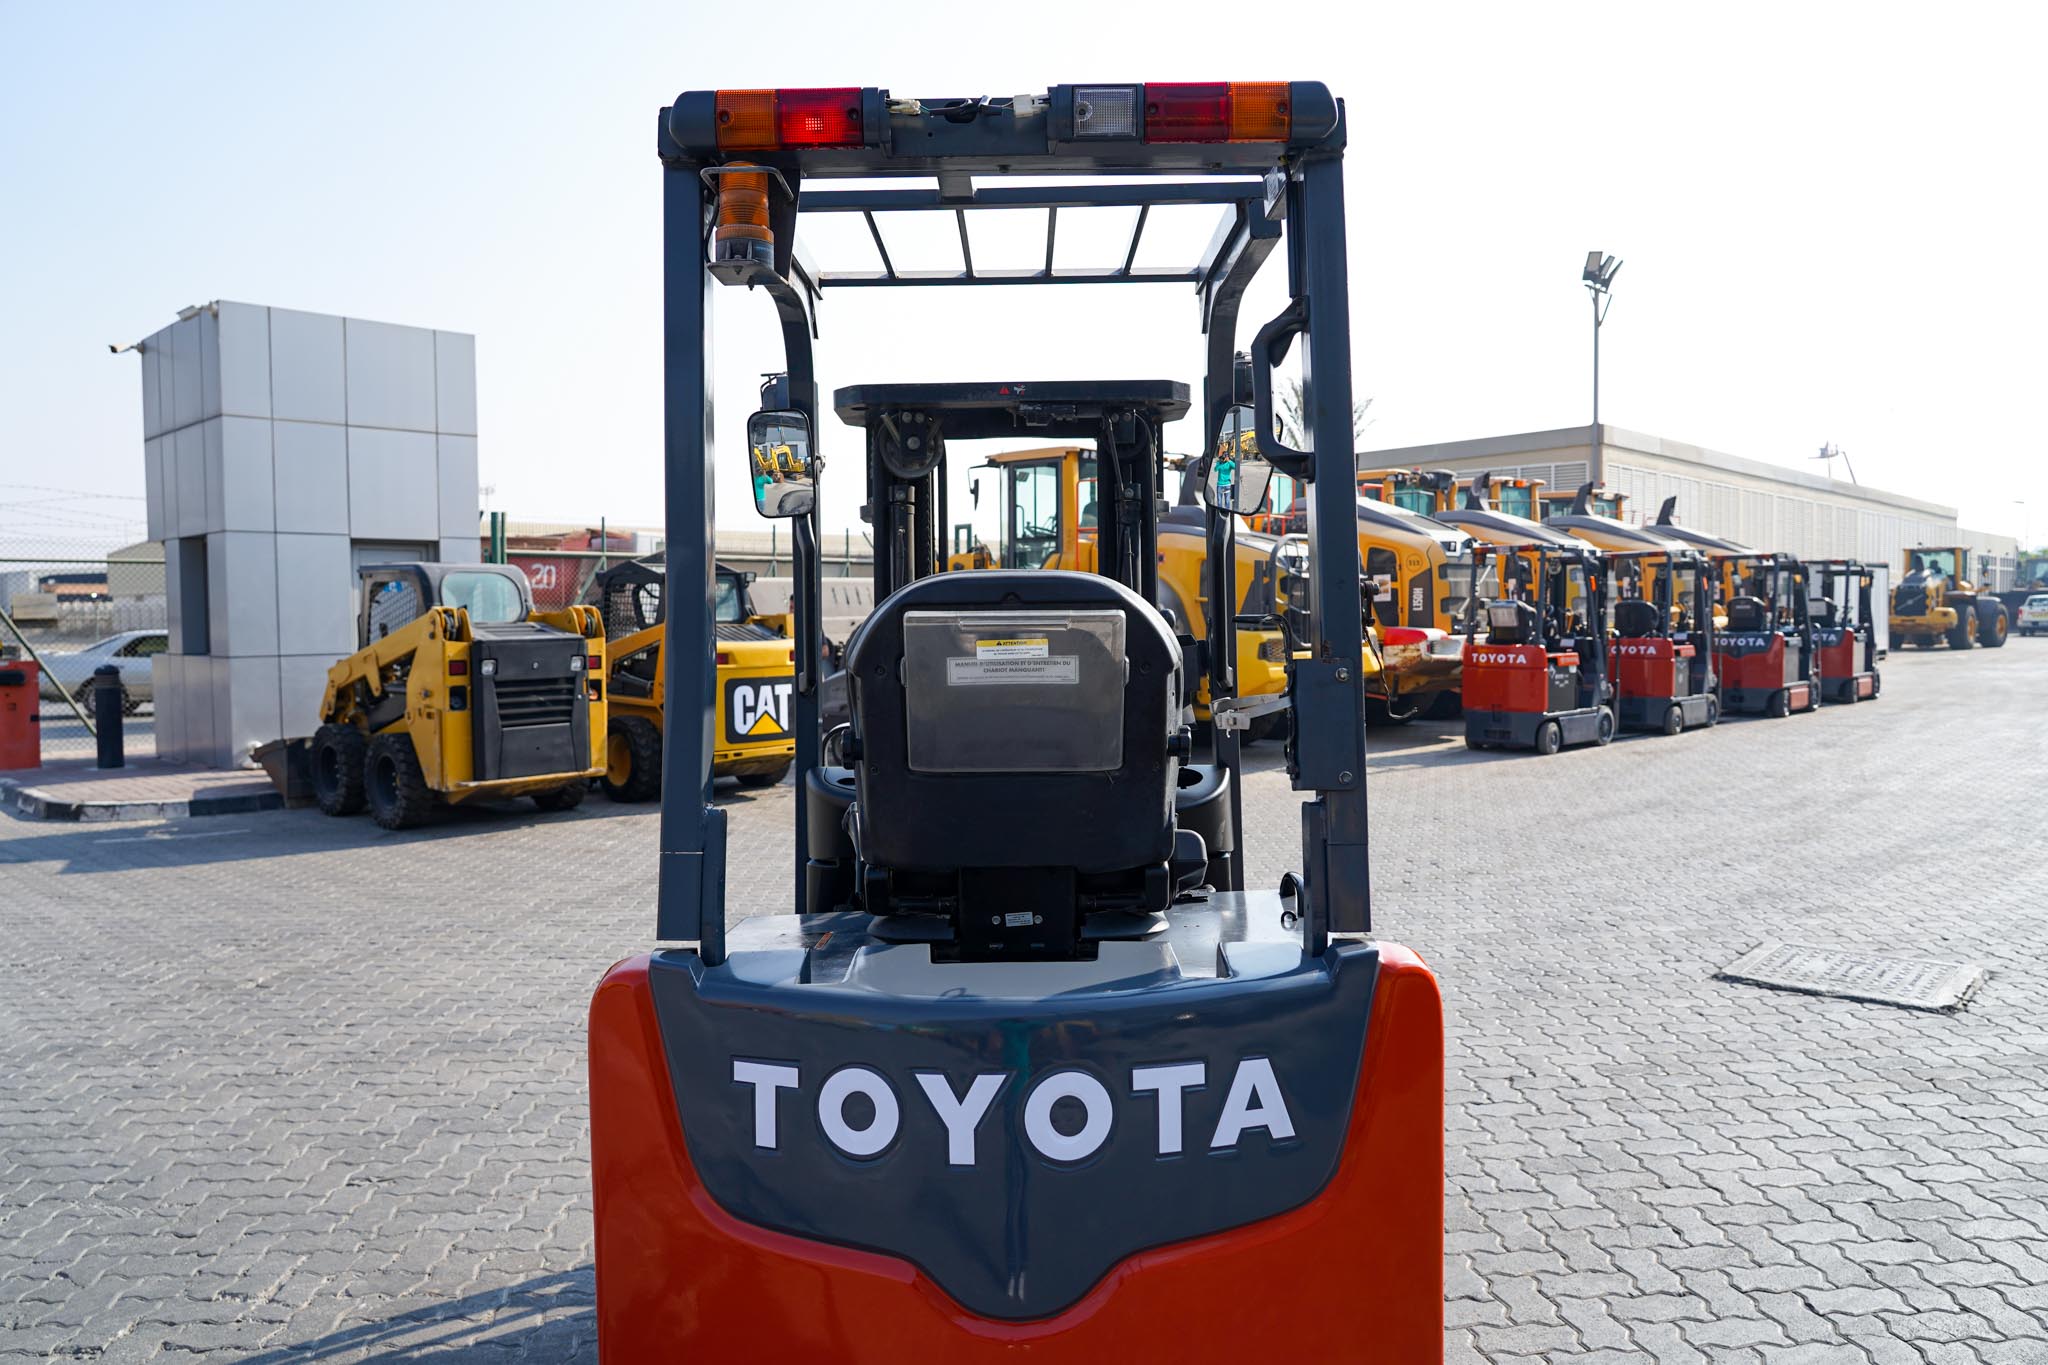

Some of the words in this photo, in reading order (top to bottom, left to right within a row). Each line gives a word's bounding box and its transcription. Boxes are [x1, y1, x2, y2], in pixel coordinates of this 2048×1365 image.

[531, 563, 556, 590] 20
[1610, 645, 1657, 655] OYOTA
[1713, 637, 1765, 646] TOYOTA
[1472, 653, 1527, 664] TOYOTA
[733, 683, 793, 735] CAT
[733, 1057, 1296, 1166] TOYOTA
